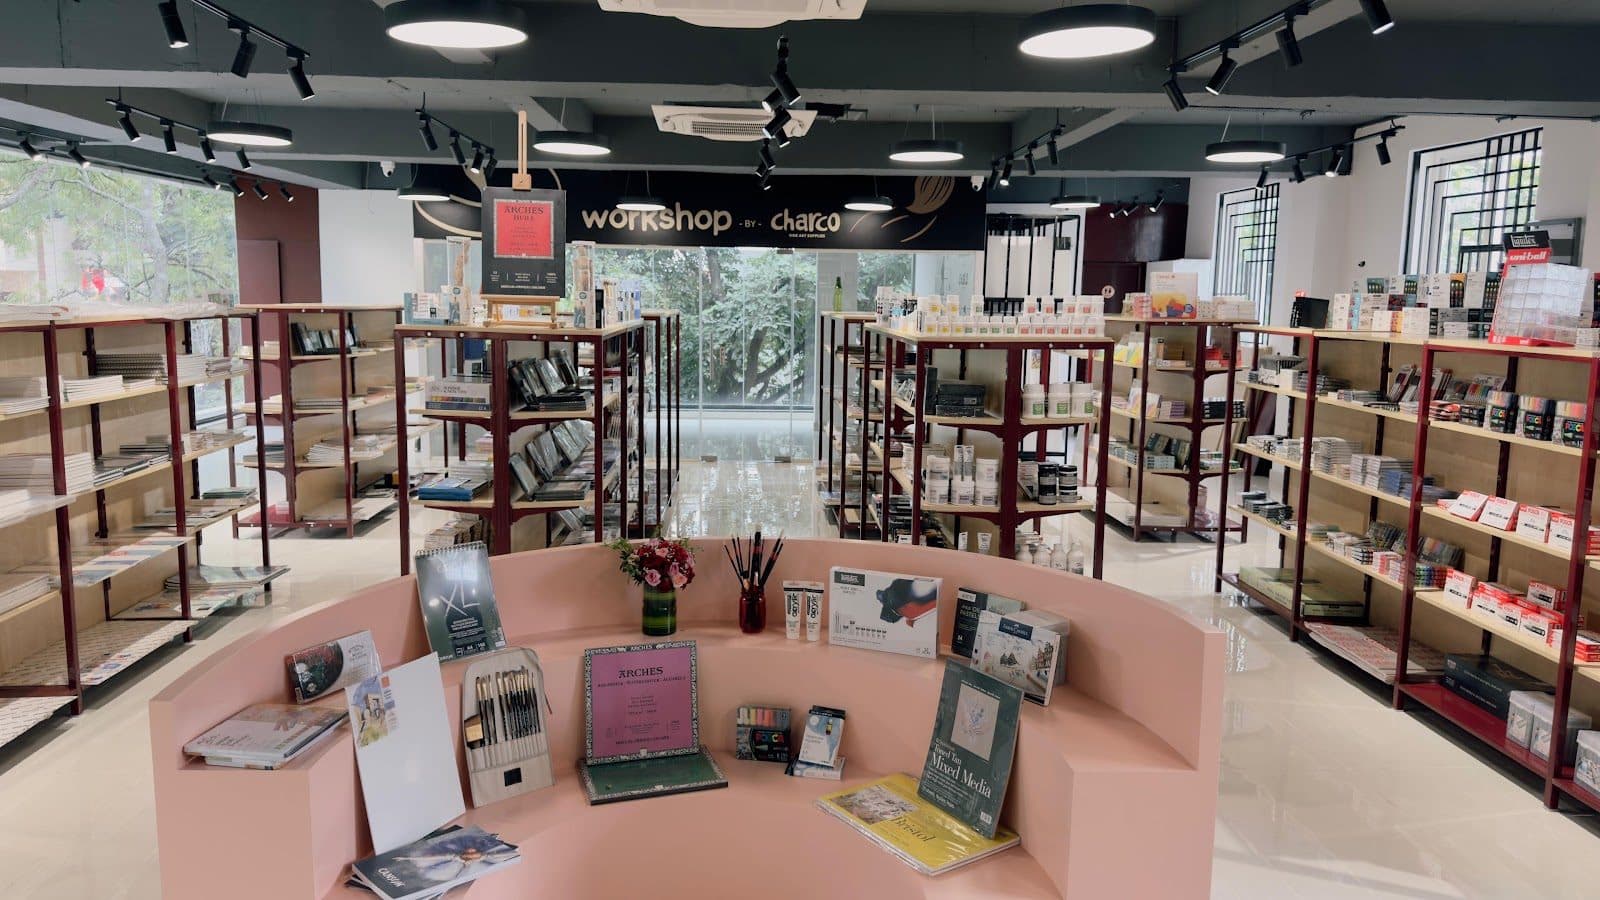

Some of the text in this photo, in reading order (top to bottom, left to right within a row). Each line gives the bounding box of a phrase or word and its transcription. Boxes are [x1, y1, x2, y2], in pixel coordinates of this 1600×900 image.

[504, 205, 544, 215] ARCHES
[582, 202, 732, 236] workshop
[771, 208, 841, 233] charco
[618, 666, 664, 679] ARCHES
[934, 744, 962, 765] Toned Tan
[930, 752, 961, 780] Mixed
[961, 768, 992, 798] Media
[890, 816, 936, 842] Bristol
